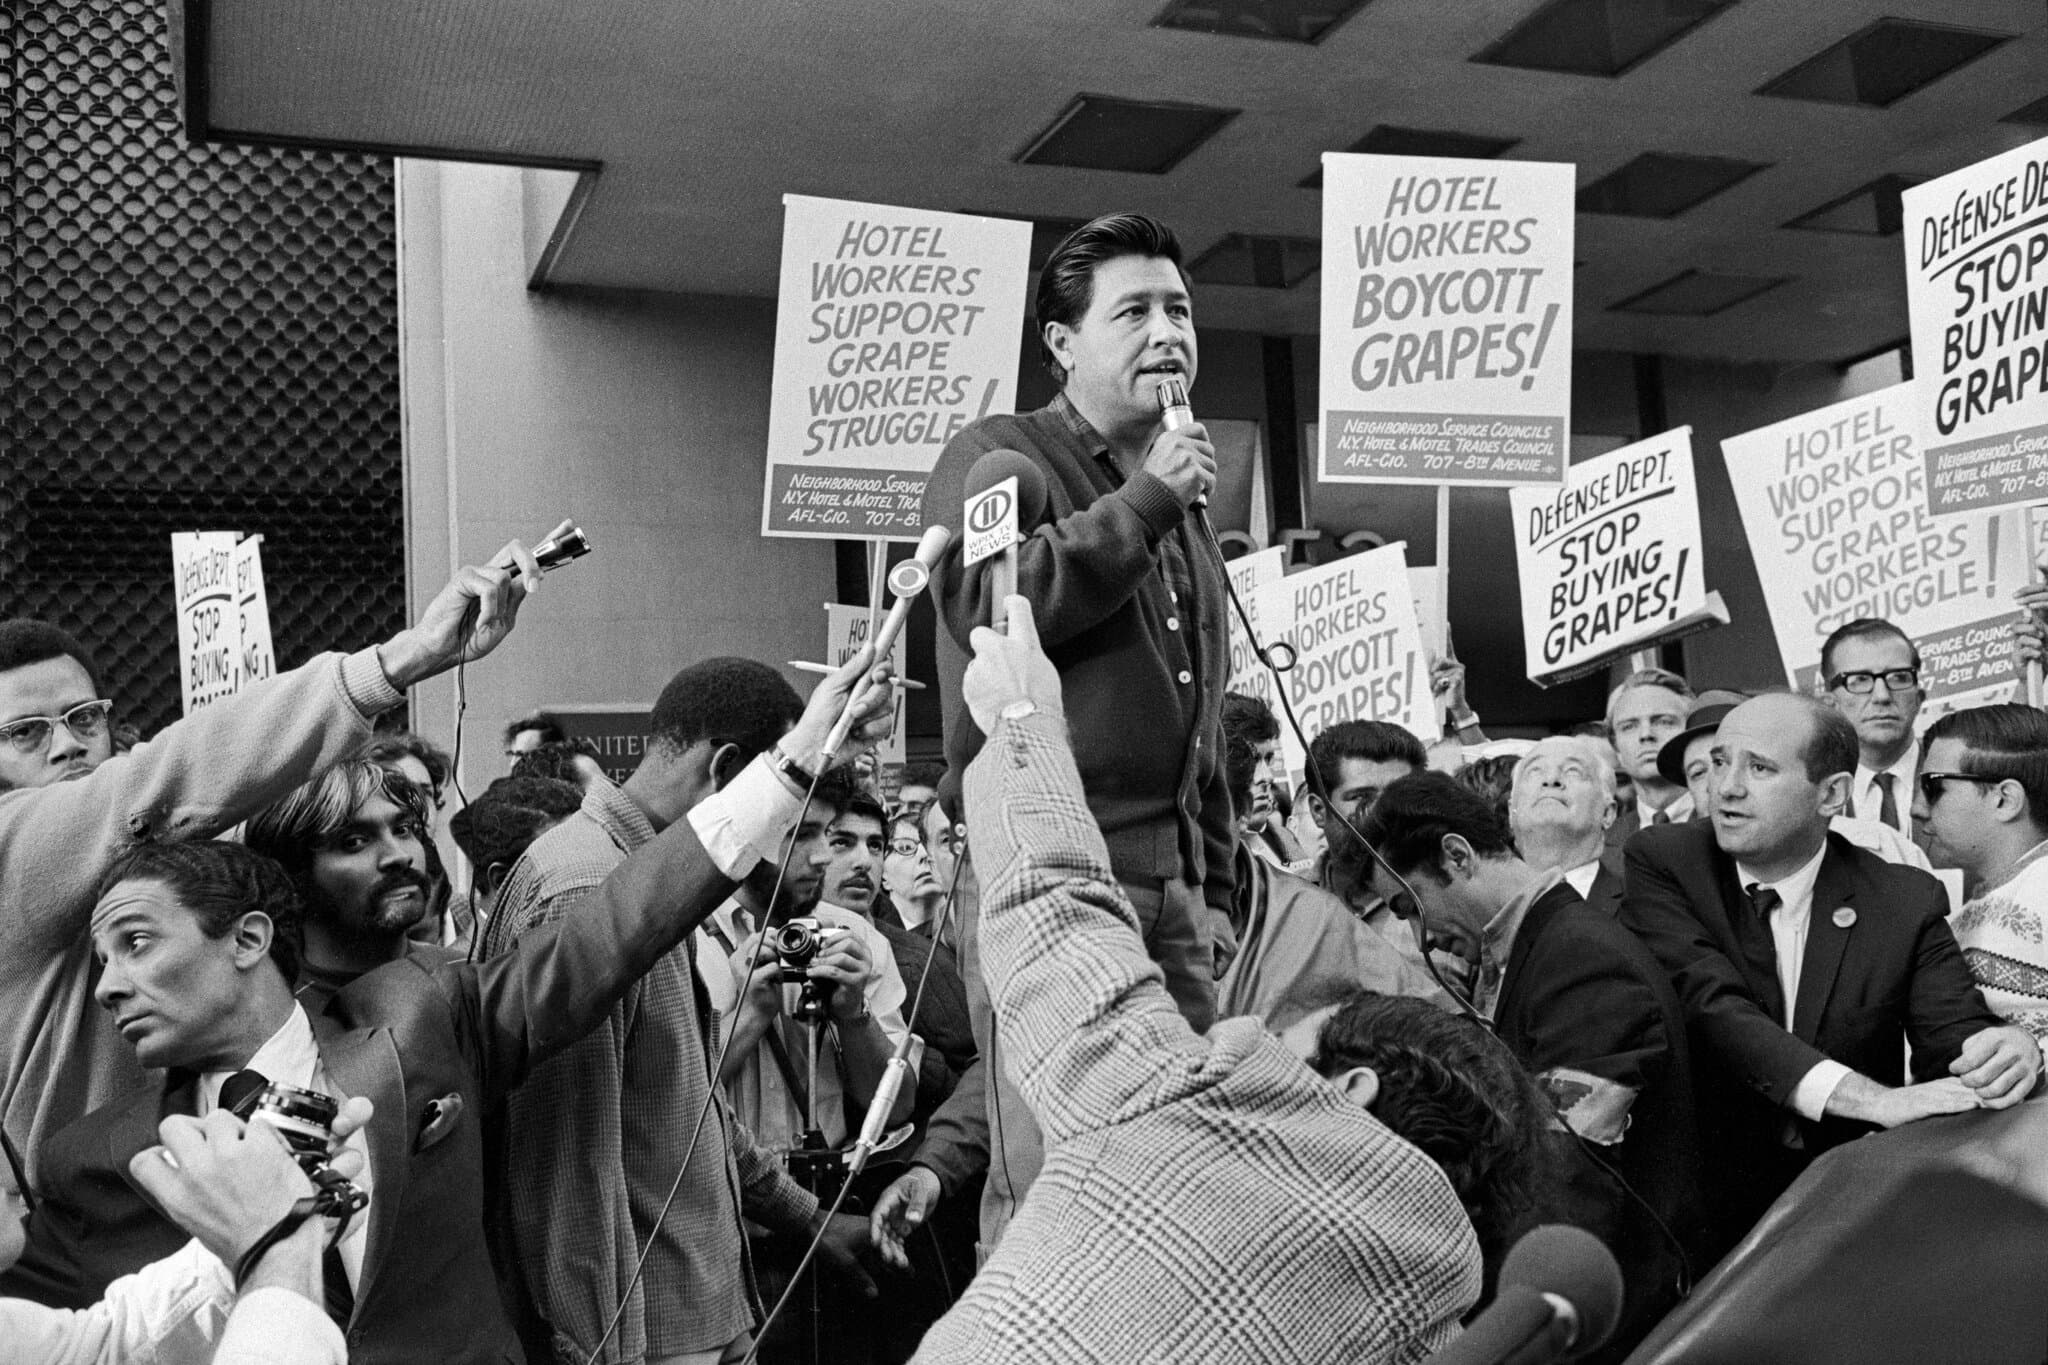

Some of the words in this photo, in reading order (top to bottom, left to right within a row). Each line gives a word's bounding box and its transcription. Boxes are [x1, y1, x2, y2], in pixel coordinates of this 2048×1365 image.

[1384, 176, 1502, 219] HOTEL
[835, 221, 947, 259] HOTEL
[1354, 217, 1539, 270] WORKERS
[810, 262, 983, 302] WORKERS
[1955, 233, 2048, 318] STOP
[1352, 268, 1544, 329] BOYCOTT
[807, 301, 986, 344] SUPPORT
[1943, 286, 2048, 375] BUYIN
[827, 341, 950, 378] GRAPE
[1351, 303, 1561, 392] GRAPES!
[808, 375, 973, 417] WORKERS
[1344, 419, 1438, 436] NEIGHBORHOOD
[1438, 418, 1489, 437] SERVICE
[1490, 422, 1552, 439] COUNCILS
[1363, 436, 1396, 450] HOTEL
[1399, 438, 1408, 450] &
[1409, 437, 1450, 452] MOTEL
[1455, 438, 1500, 454] TRADES
[1502, 439, 1554, 456] COUNCIL
[1785, 406, 1895, 475] HOTEL
[789, 473, 881, 492] NEIGHBORHOOD
[1490, 457, 1541, 472] AVENUE
[1615, 450, 1673, 499] DEPT.
[1989, 459, 2022, 478] MOTEL
[808, 491, 840, 506] HOTEL
[843, 495, 851, 506] &
[852, 493, 893, 509] MOTEL
[970, 532, 1010, 560] NEWS
[1559, 512, 1640, 578] STOP
[1812, 504, 1935, 575] GRAPE
[1232, 567, 1258, 599] OTEL
[1550, 540, 1664, 620] BUYING
[1802, 523, 1968, 616] WORKERS
[1295, 569, 1361, 622] HOTEL
[1543, 547, 1689, 665] GRAPES!
[193, 607, 220, 650] STOP
[1280, 591, 1387, 662] WORKERS
[191, 647, 229, 691] BUYING
[1291, 628, 1398, 707] BOYCOTT
[1931, 648, 1981, 671] TRADES
